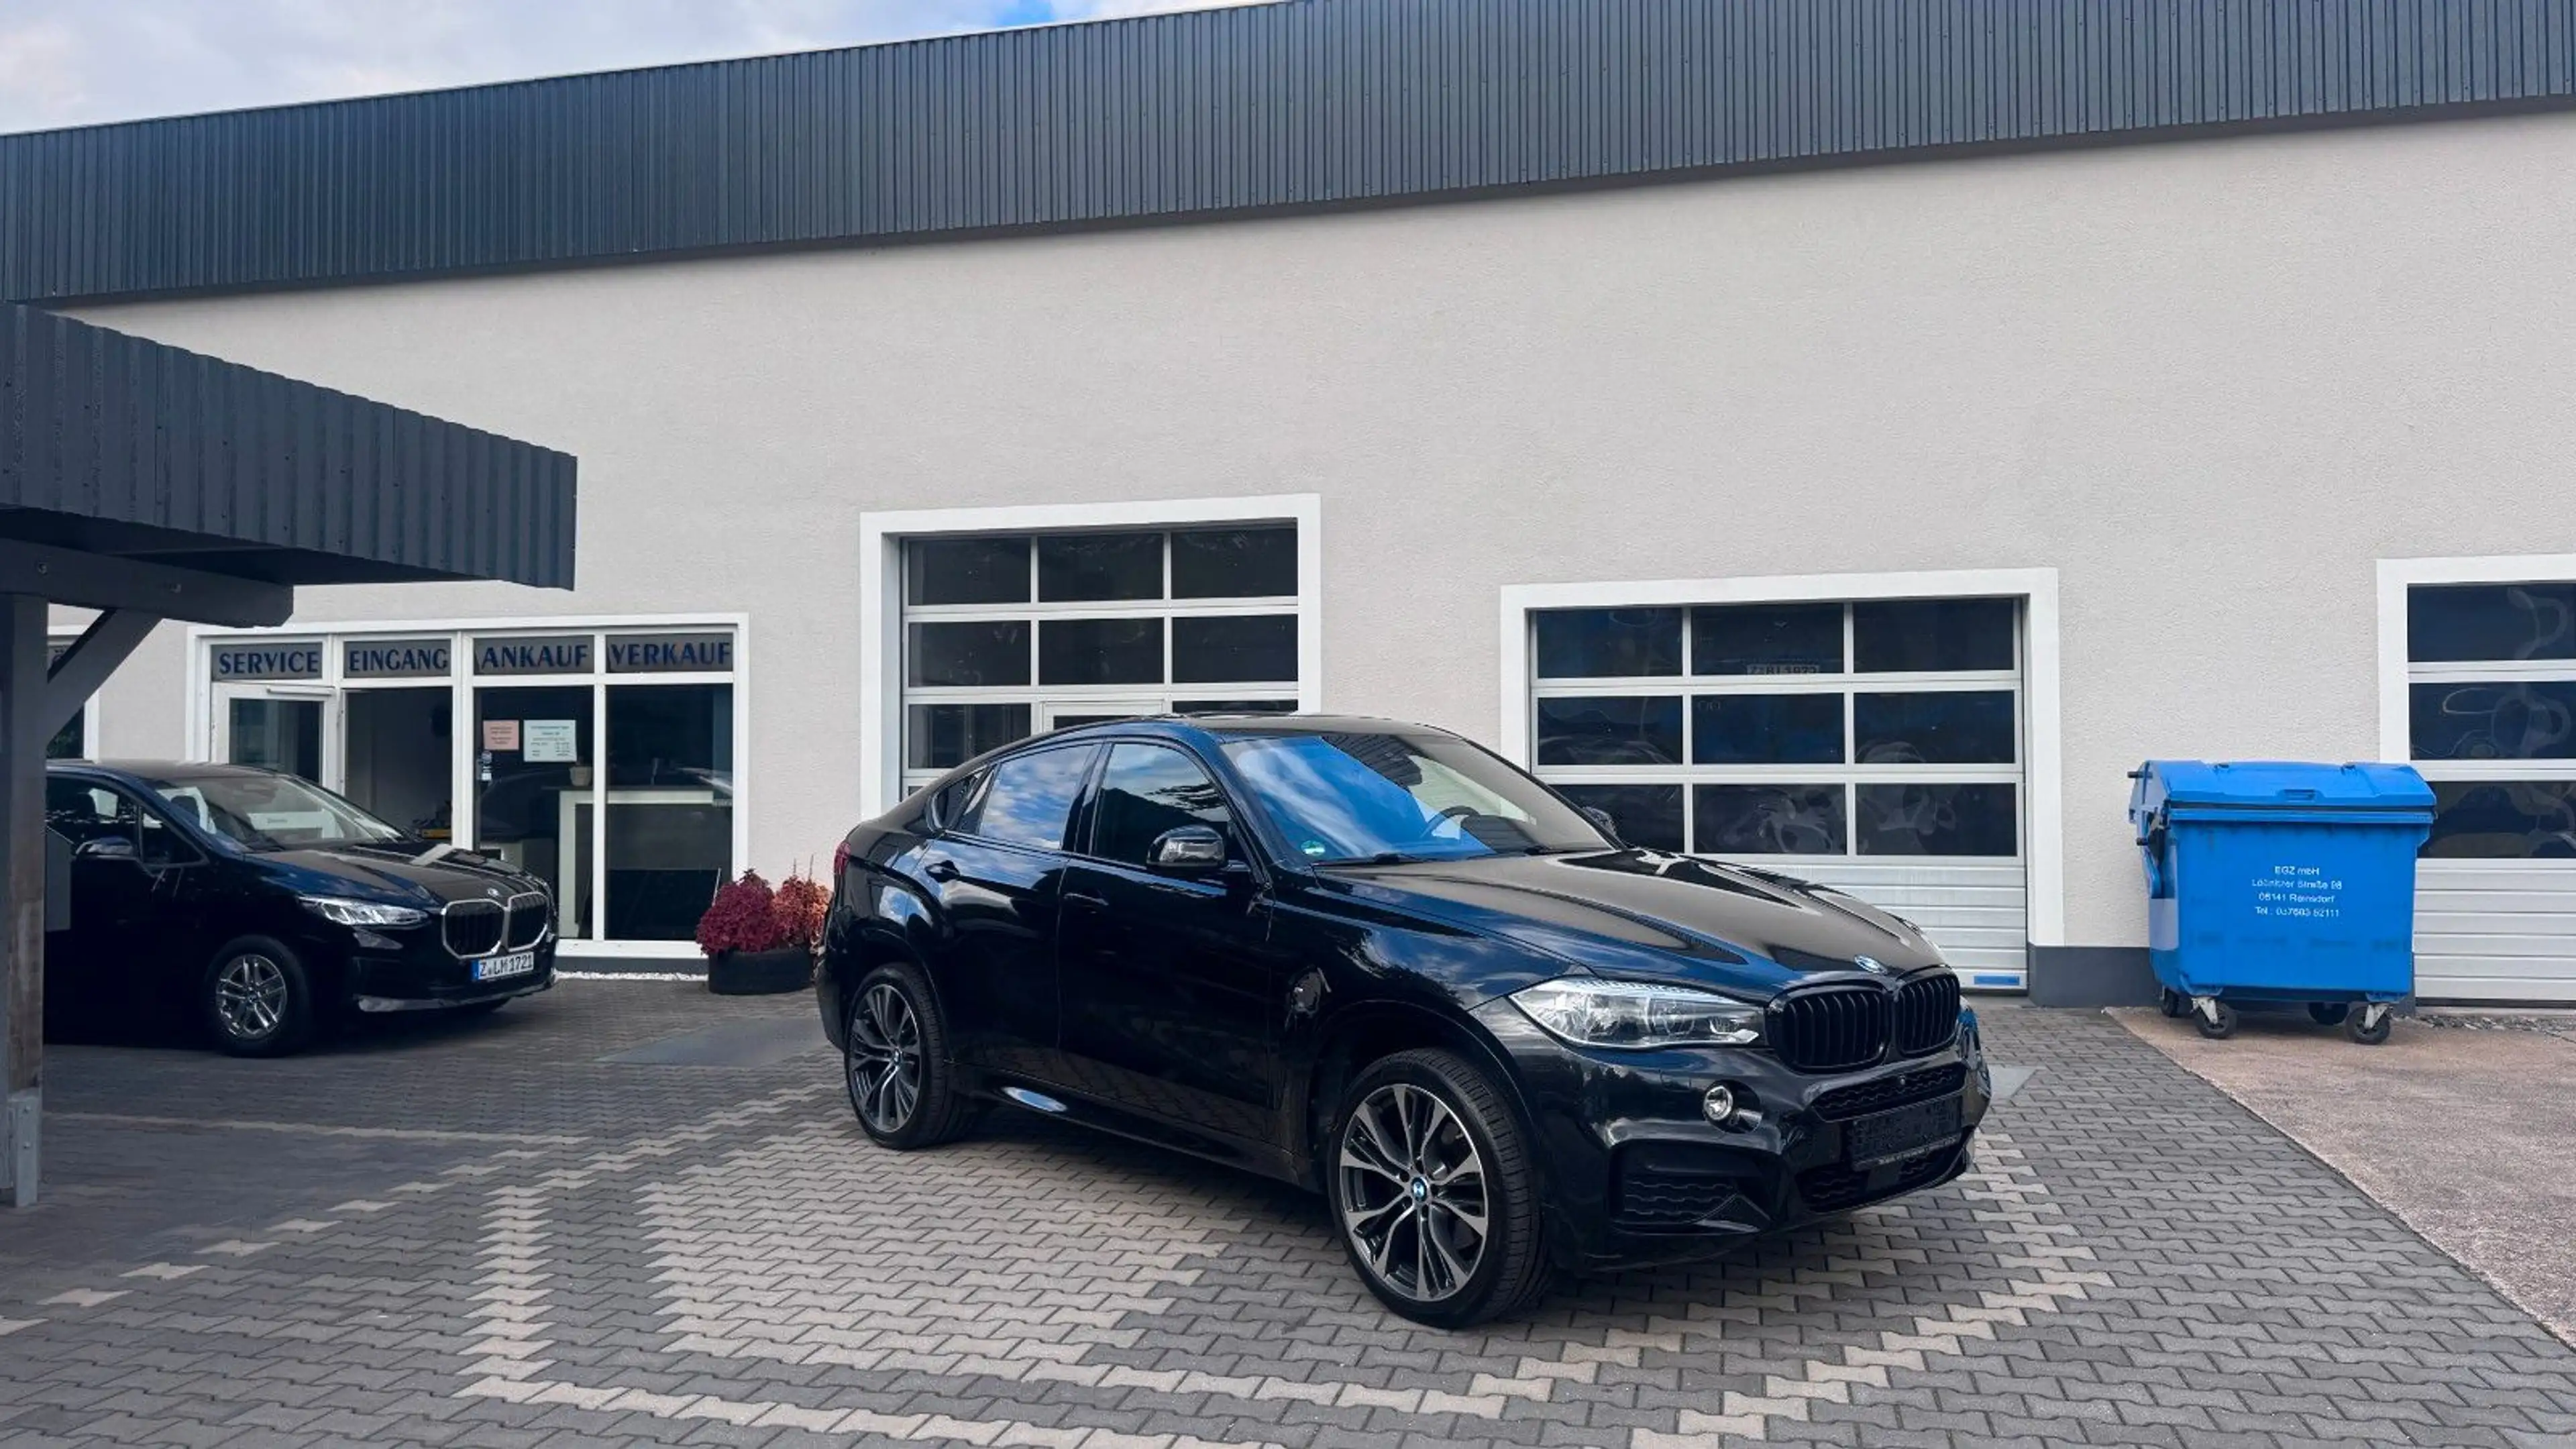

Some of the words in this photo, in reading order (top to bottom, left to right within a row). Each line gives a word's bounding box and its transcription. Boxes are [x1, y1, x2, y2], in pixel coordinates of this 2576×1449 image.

[219, 651, 319, 674] SERVICE
[349, 648, 448, 671] EINGANG
[481, 643, 588, 669] ANKAUF
[610, 641, 731, 666] VERKAUF
[2274, 865, 2296, 875] EGZ
